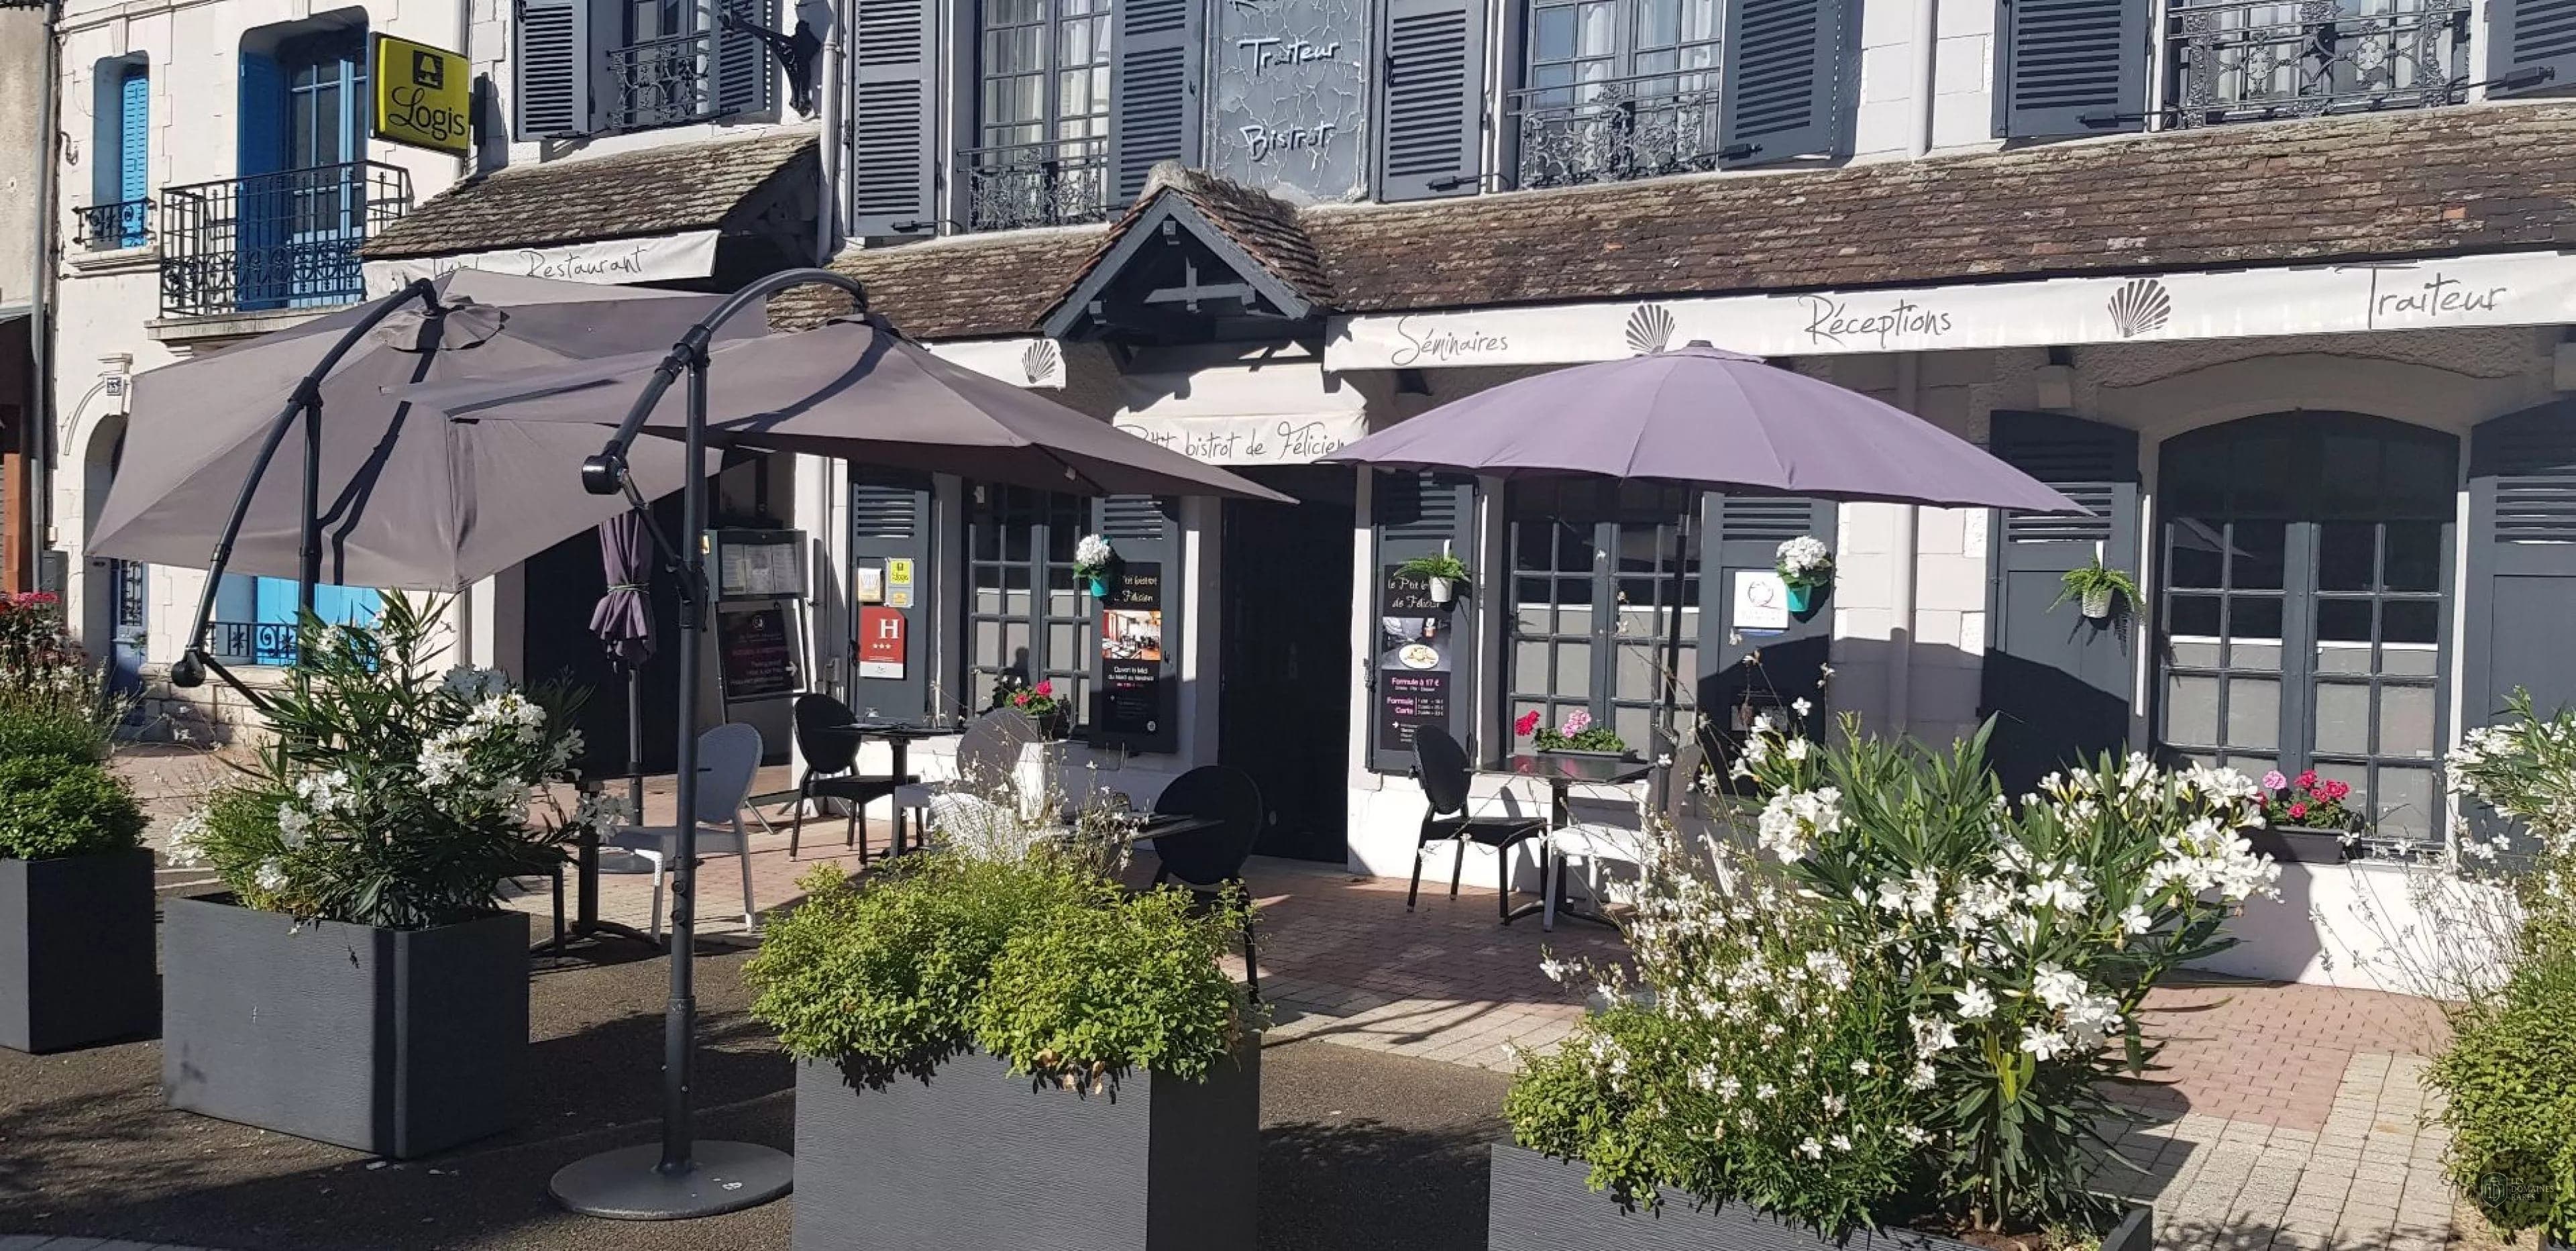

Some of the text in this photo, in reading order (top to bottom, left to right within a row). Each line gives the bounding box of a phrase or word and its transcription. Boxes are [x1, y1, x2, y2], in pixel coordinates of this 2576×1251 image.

[388, 87, 465, 142] Logis
[1239, 120, 1336, 162] Bistrot
[519, 245, 649, 278] Restaurant
[2334, 264, 2508, 329] Traiteur
[1391, 315, 1508, 366] Séminaires
[1798, 295, 1951, 349] Réceptions
[1185, 430, 1242, 459] bistrot
[1246, 428, 1267, 457] de
[879, 618, 900, 639] H
